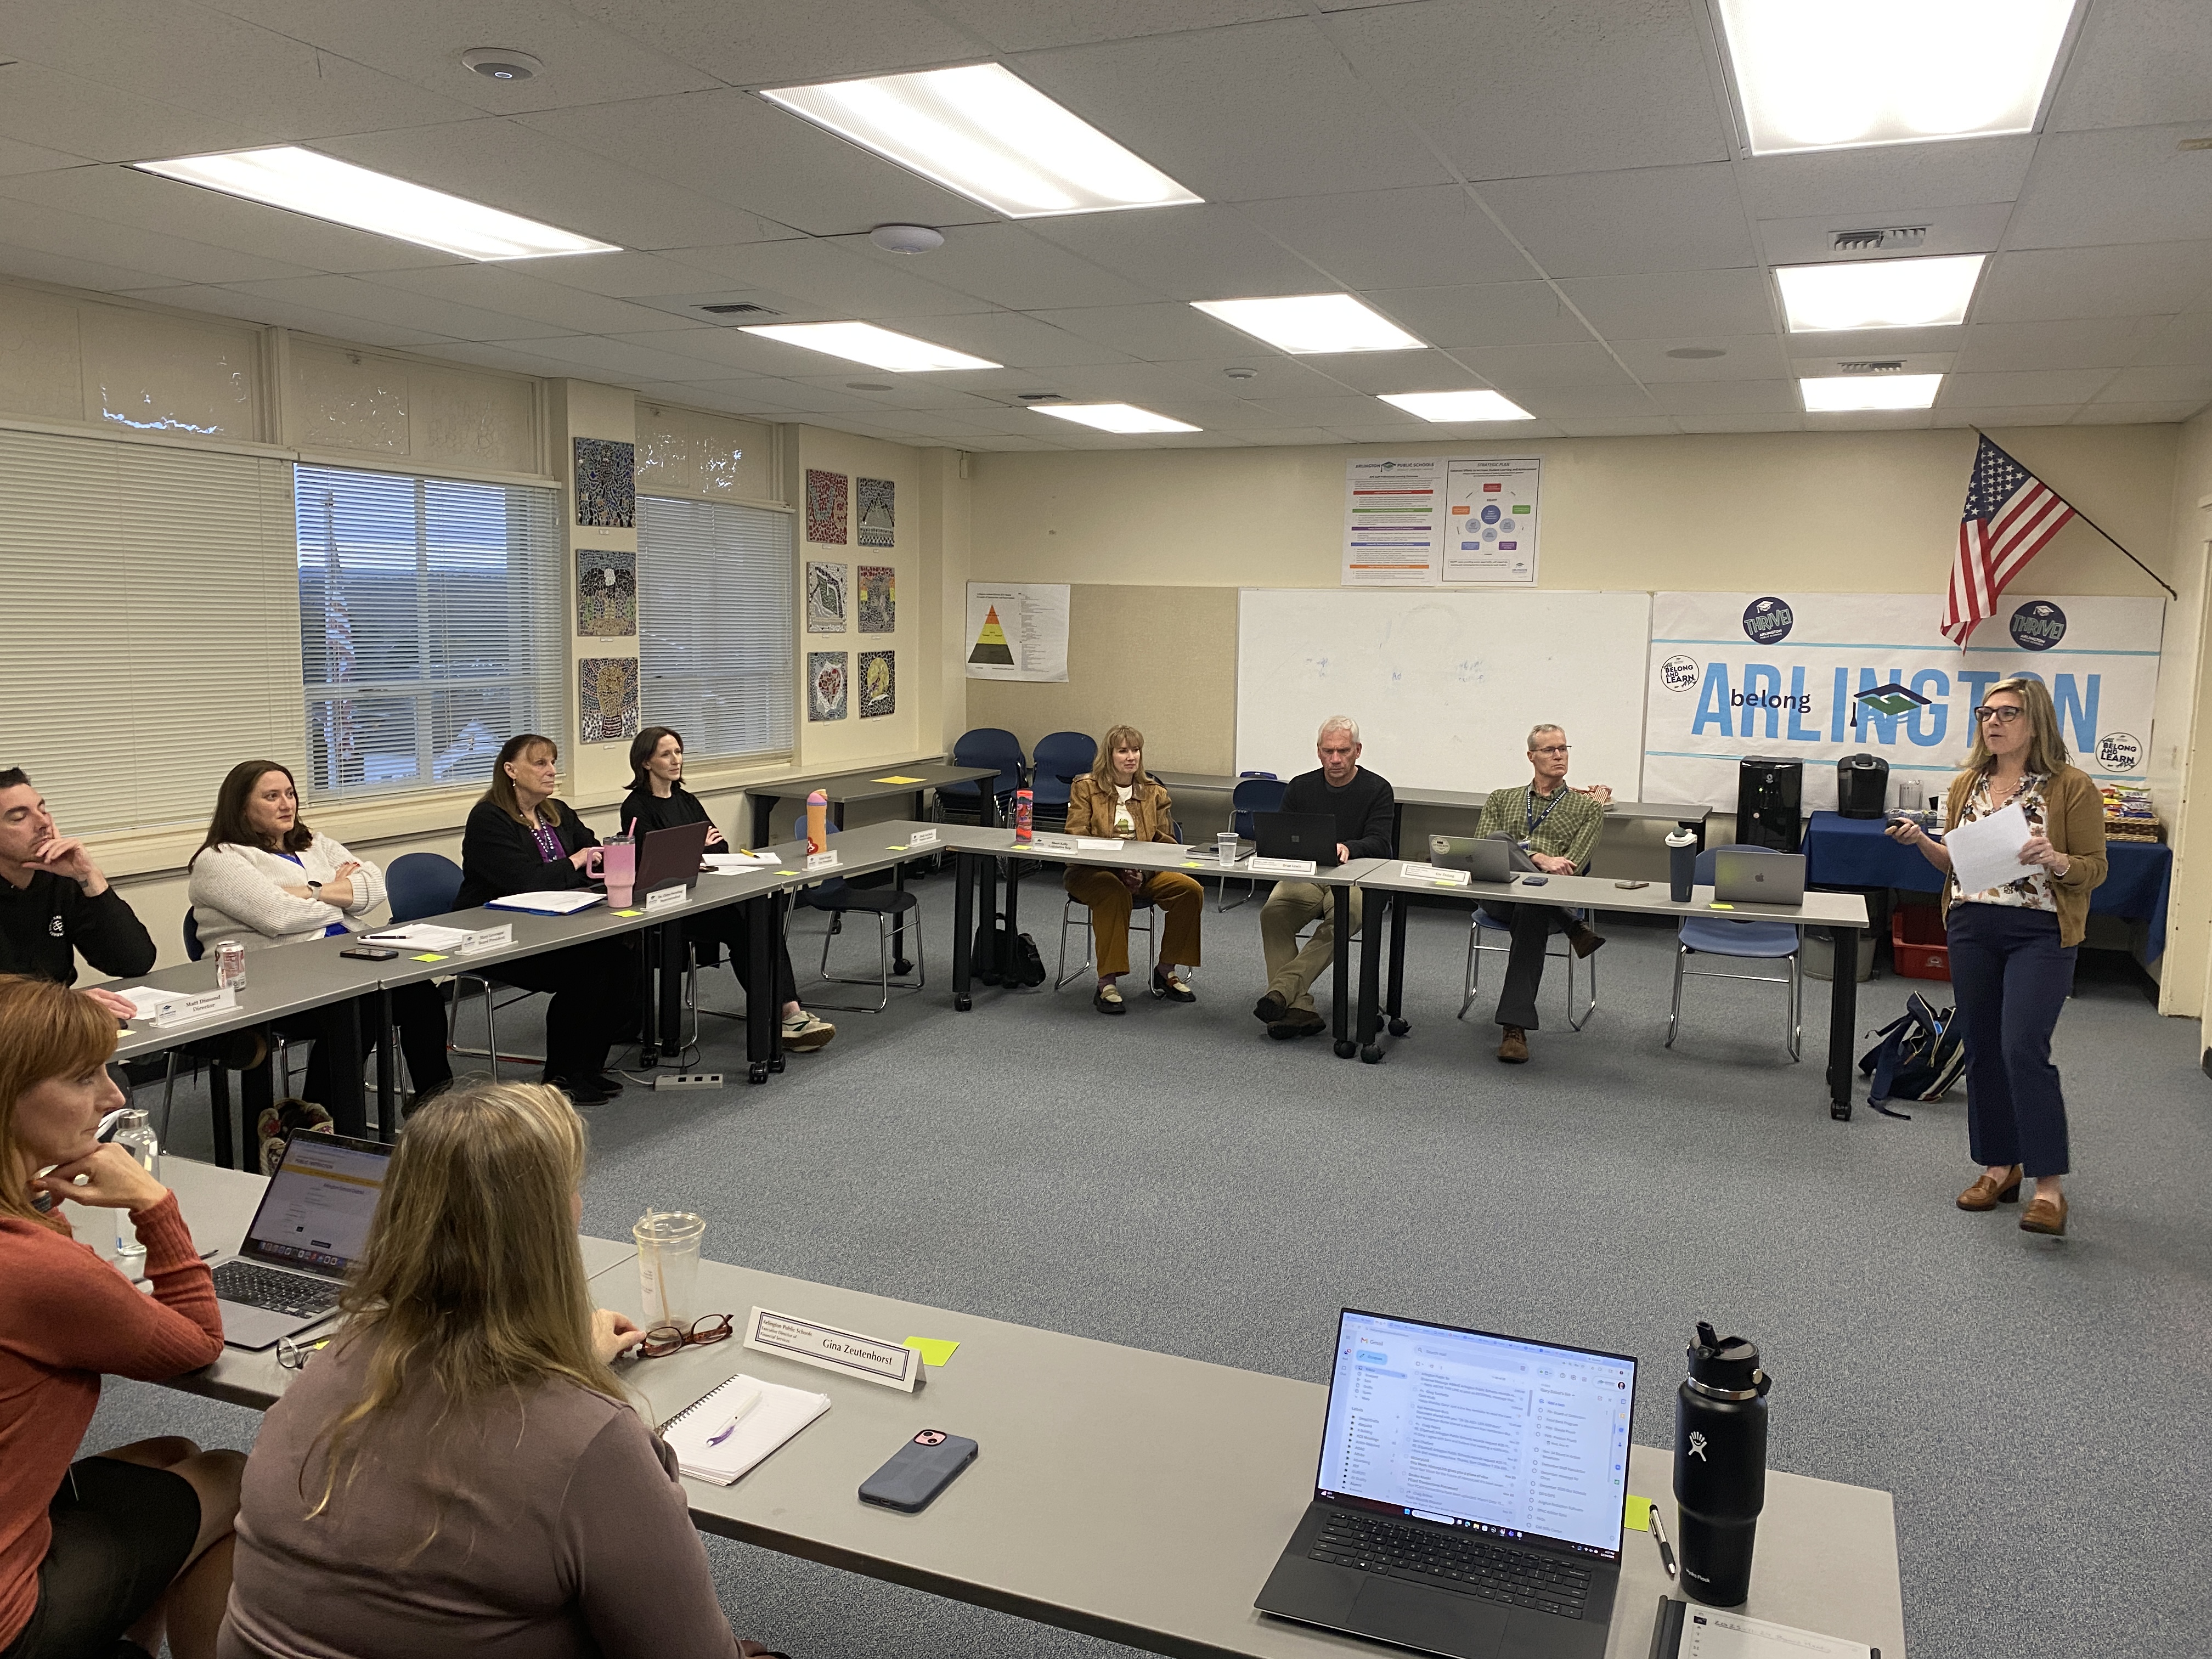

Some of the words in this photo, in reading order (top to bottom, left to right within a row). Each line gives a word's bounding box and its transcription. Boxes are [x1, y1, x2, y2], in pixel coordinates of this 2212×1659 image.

[1744, 609, 1792, 635] THRIVE!
[2013, 614, 2064, 640] THRIVE!
[2021, 635, 2046, 644] ARLINGTON
[1666, 664, 1694, 673] BELONG
[1666, 674, 1694, 684] LEARN
[1731, 687, 1811, 713] belong
[2103, 742, 2137, 752] BELONG
[2101, 753, 2135, 764] LEARN
[199, 995, 221, 1005] Dimond
[193, 1003, 216, 1012] Director
[763, 1319, 782, 1328] Arlington
[782, 1324, 795, 1333] Public
[796, 1328, 812, 1337] Schools
[822, 1339, 841, 1352] Gina
[844, 1344, 893, 1365] Zeutenhorst
[1697, 1575, 1710, 1583] Flask
